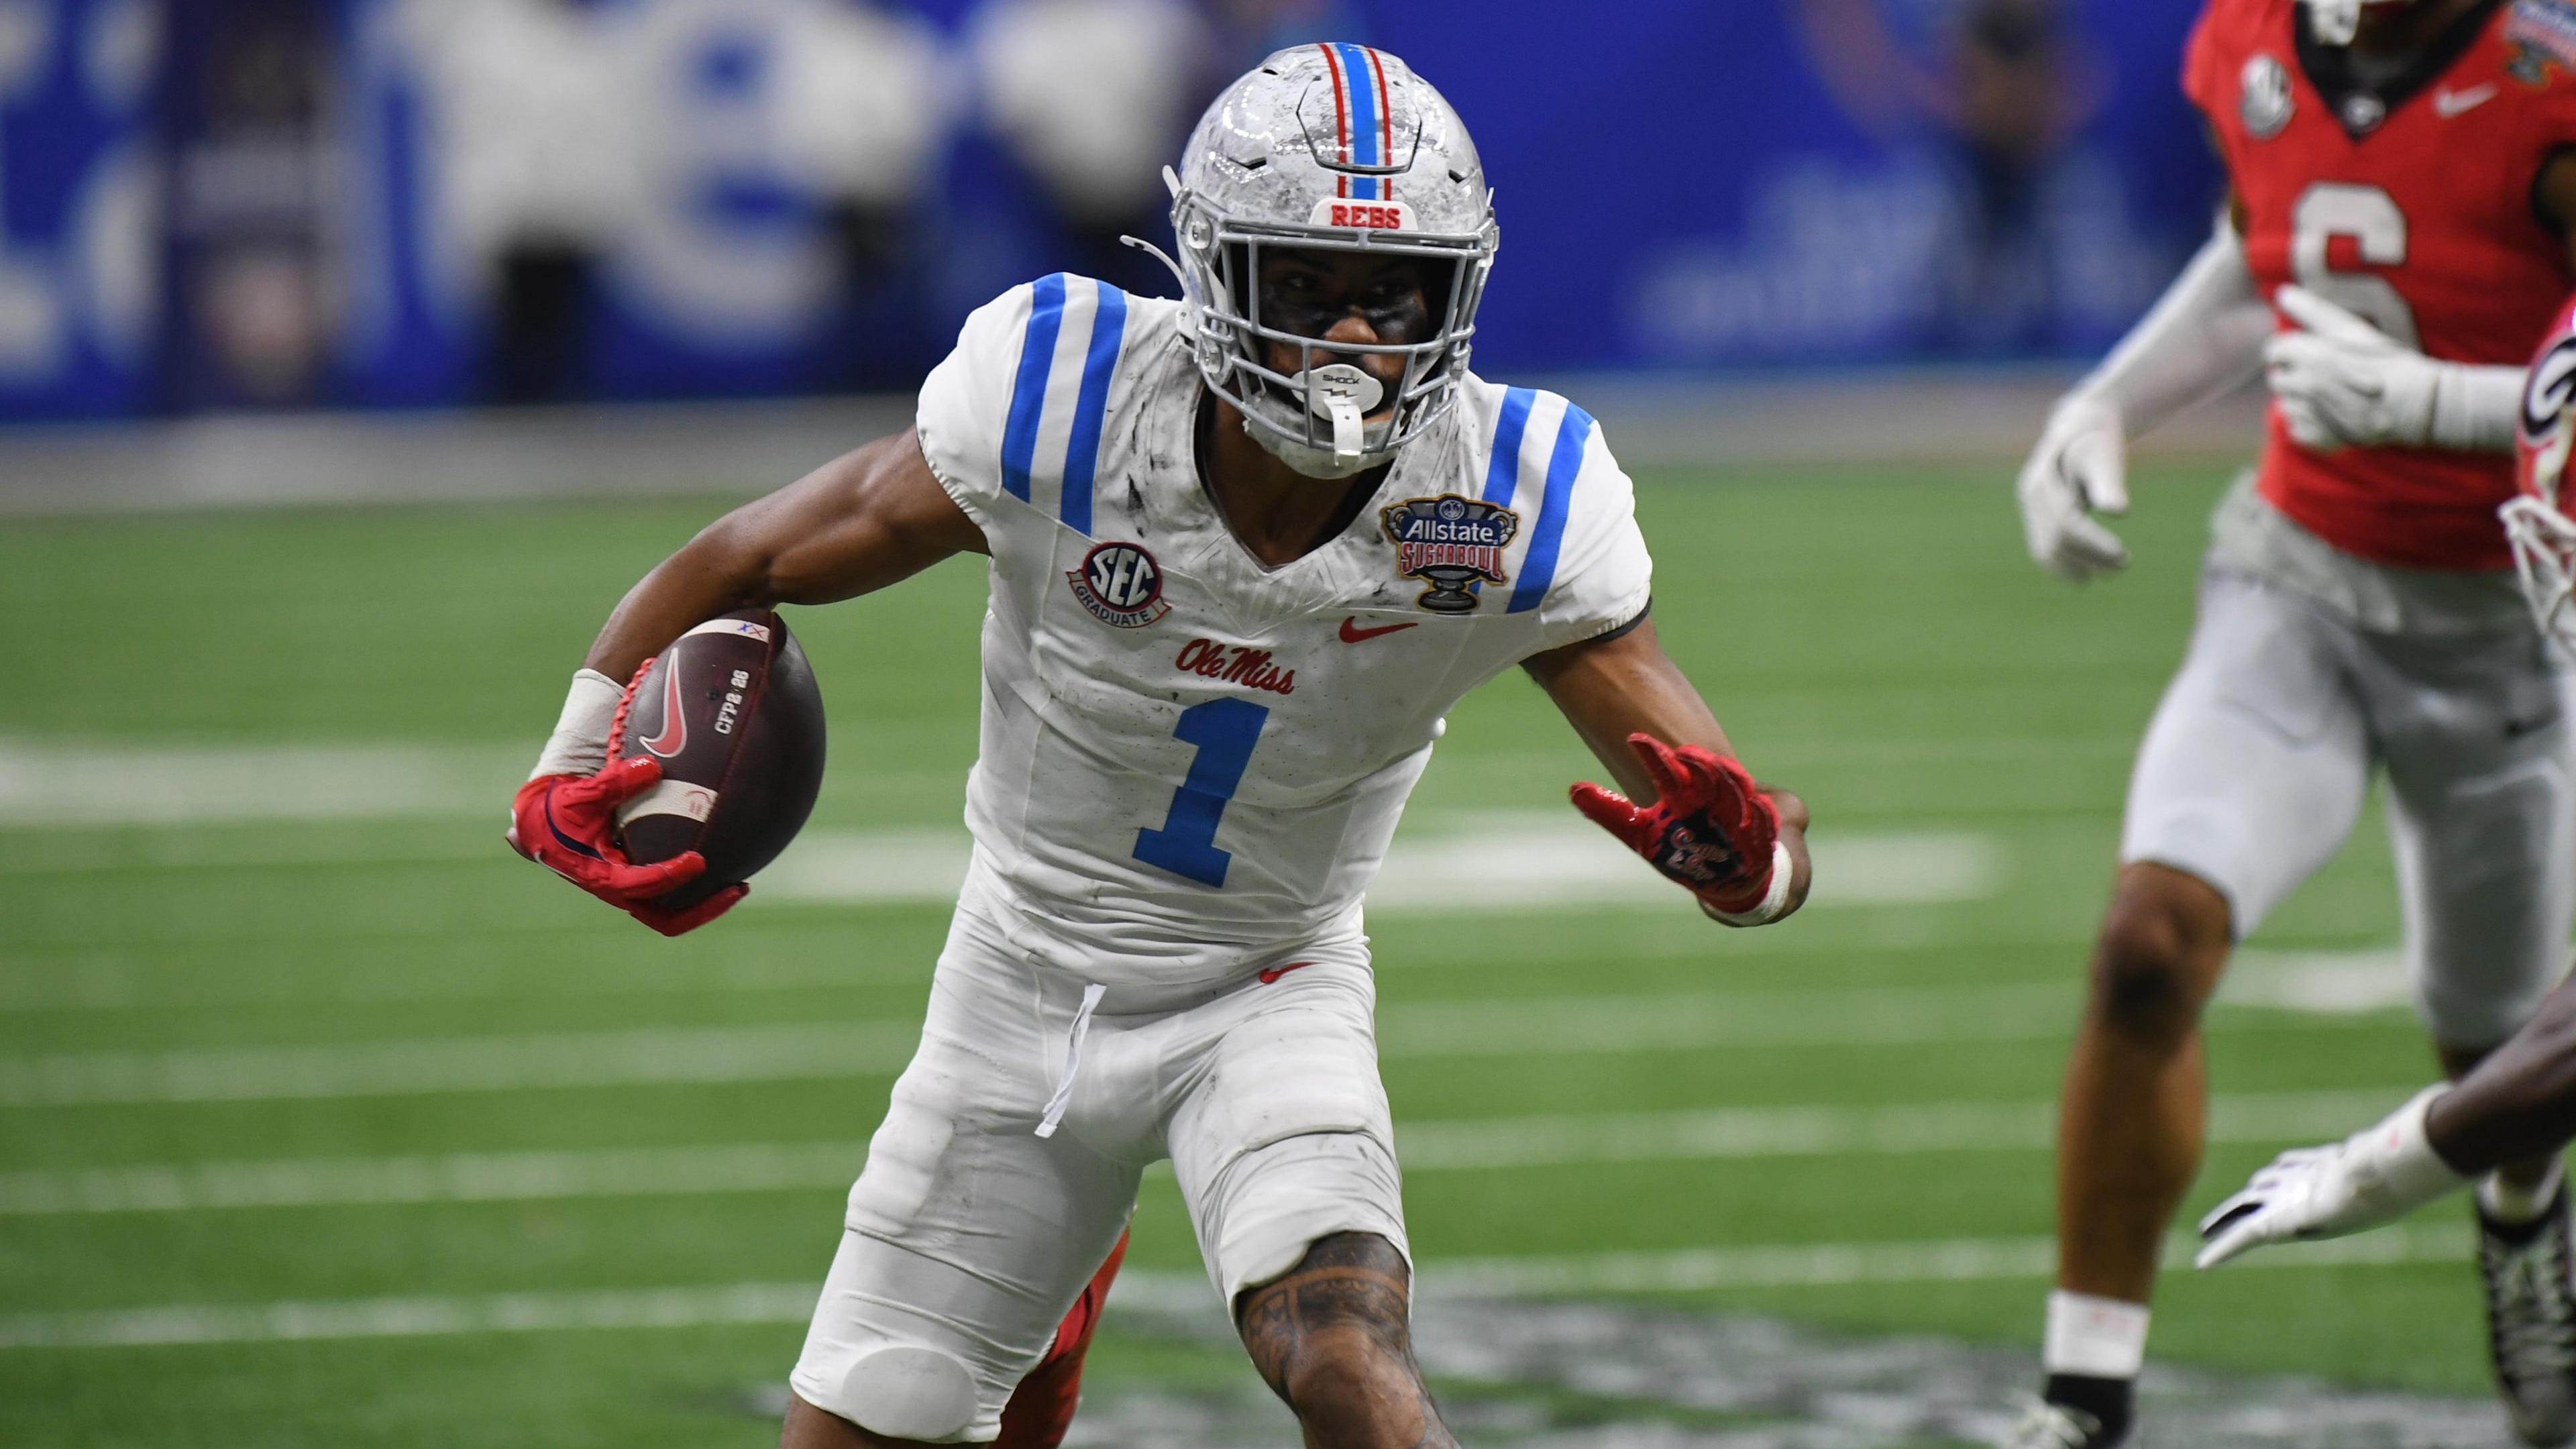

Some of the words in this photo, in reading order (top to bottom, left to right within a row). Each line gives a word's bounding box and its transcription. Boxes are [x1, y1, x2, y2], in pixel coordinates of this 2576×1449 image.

[1330, 205, 1401, 229] REBS
[1322, 374, 1360, 384] SHOCK
[1405, 519, 1494, 543] Allstate
[1090, 547, 1155, 606] SEC
[1076, 585, 1151, 626] GRADUATE
[1175, 639, 1226, 678] Ole
[1222, 647, 1295, 695] Miss
[1132, 696, 1270, 889] 1
